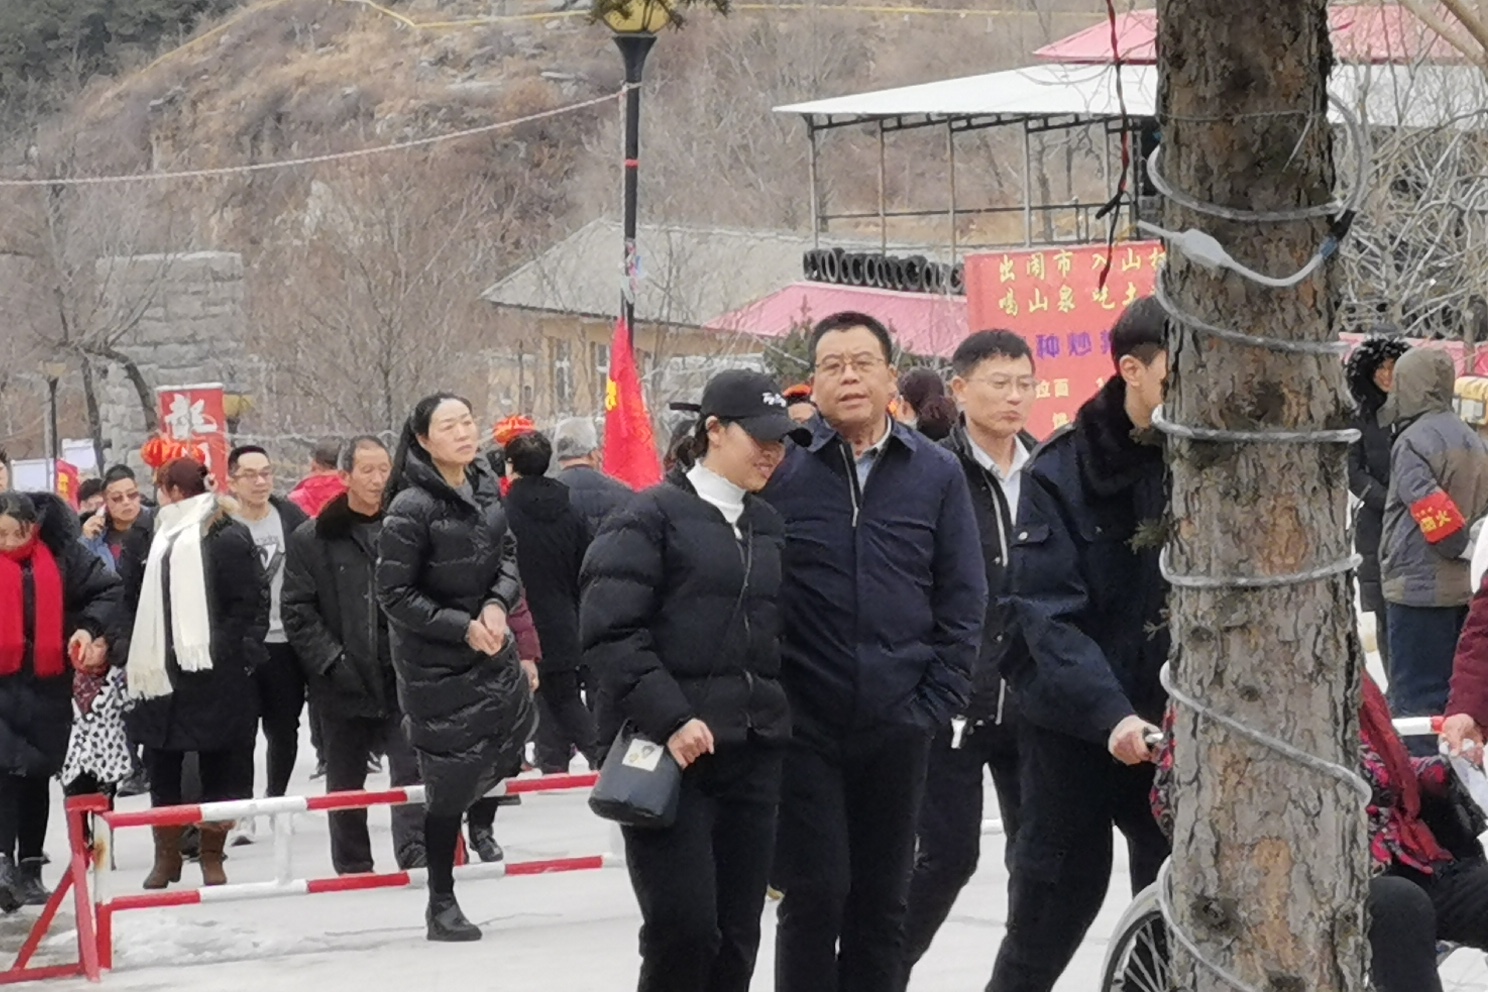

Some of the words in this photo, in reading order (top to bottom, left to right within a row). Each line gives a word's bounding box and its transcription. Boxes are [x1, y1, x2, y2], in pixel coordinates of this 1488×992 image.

[998, 282, 1156, 316] 喝山泉吃土
